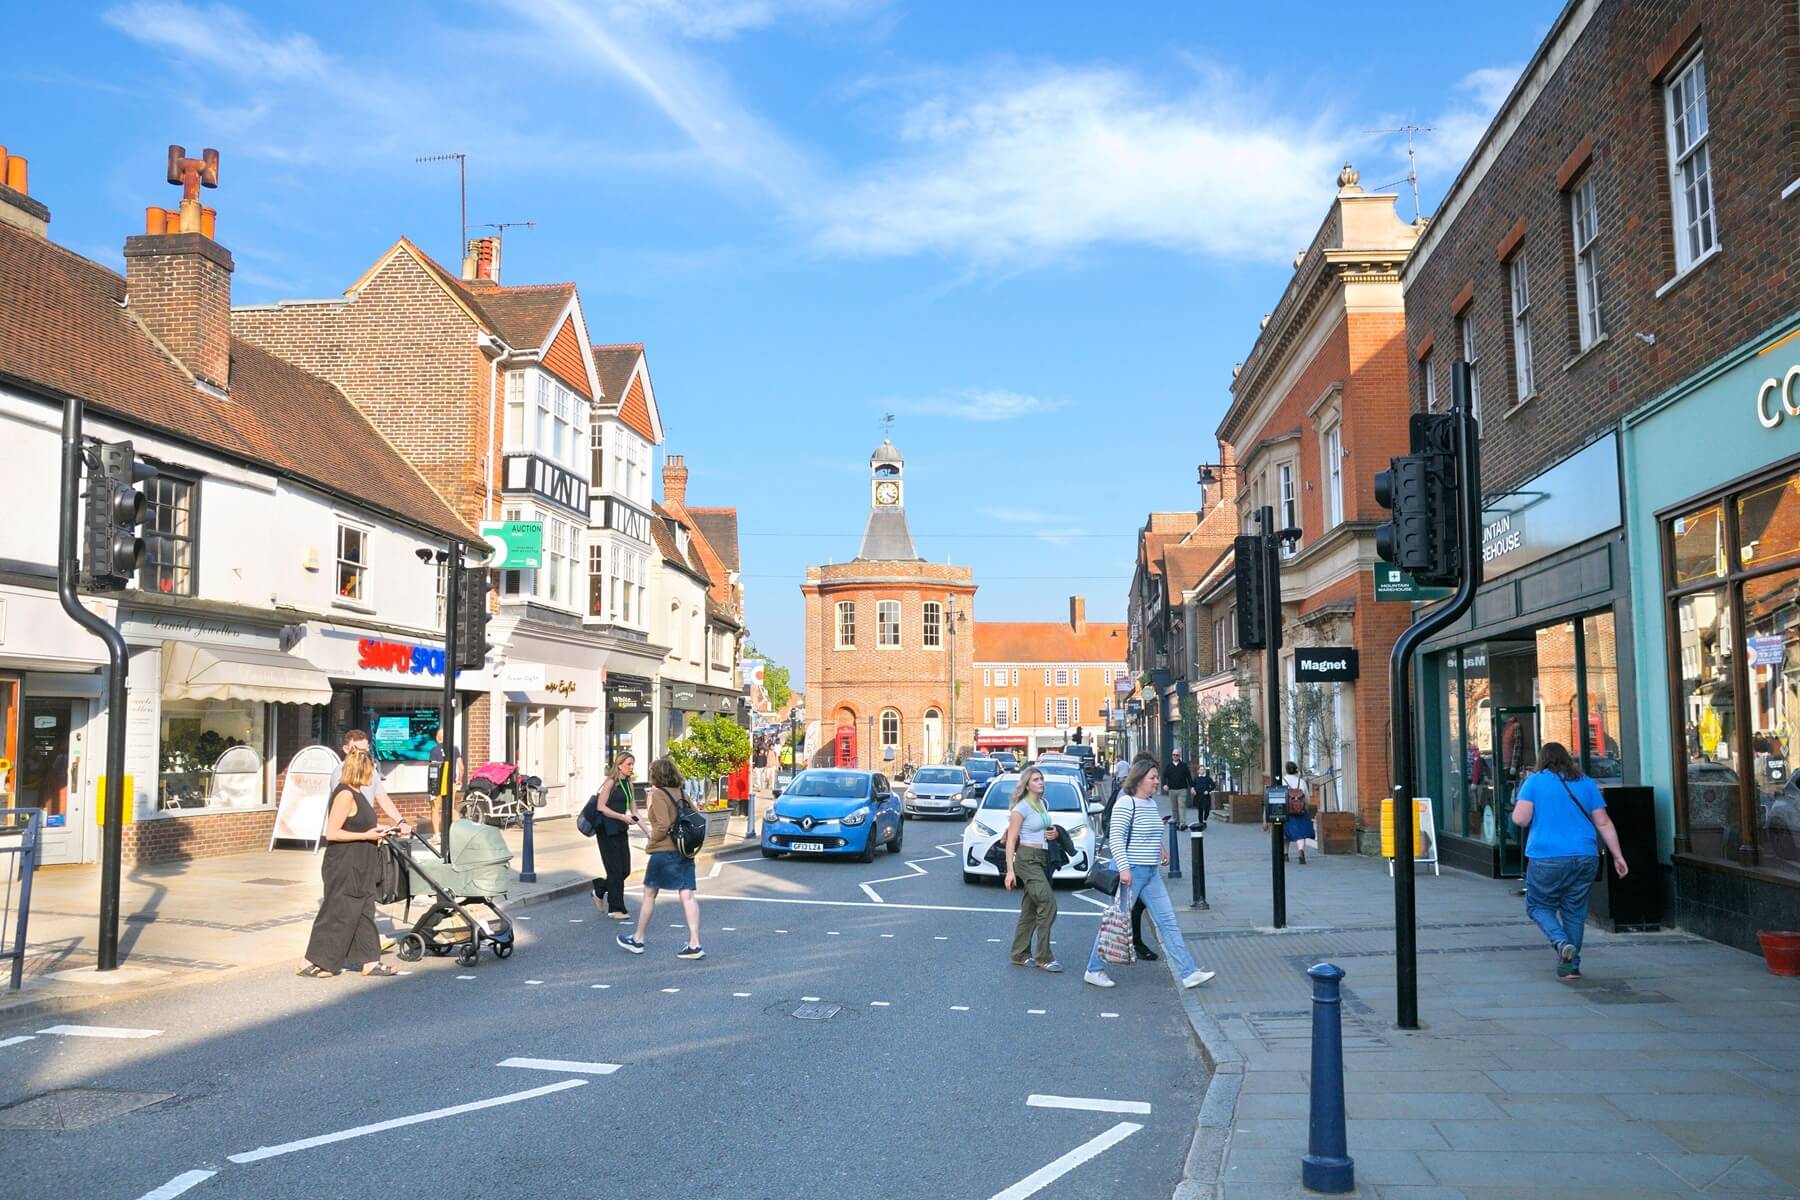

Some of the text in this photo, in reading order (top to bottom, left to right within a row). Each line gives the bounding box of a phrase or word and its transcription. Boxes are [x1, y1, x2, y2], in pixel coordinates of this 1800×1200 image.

[512, 524, 542, 533] AUCTION
[1482, 515, 1510, 544] UNTAIN
[1482, 531, 1521, 562] REHOUSE
[193, 621, 240, 641] Jewellers
[1300, 659, 1348, 673] Magnet
